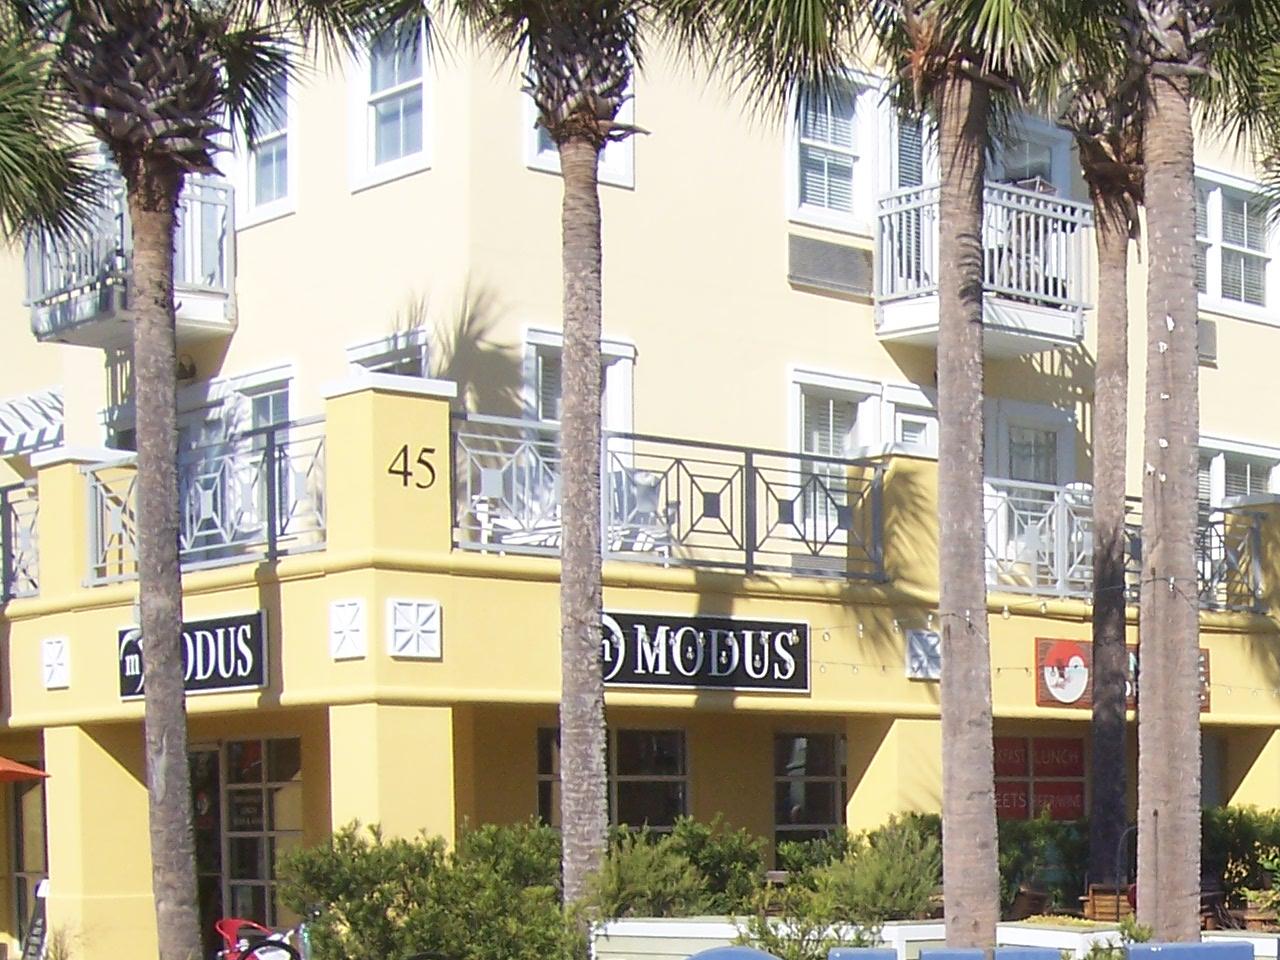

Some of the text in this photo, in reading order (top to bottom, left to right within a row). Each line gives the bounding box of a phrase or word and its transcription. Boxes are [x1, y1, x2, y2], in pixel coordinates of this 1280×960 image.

[387, 443, 436, 489] 45
[183, 624, 254, 682] ODUS
[633, 624, 796, 680] MODUS
[1034, 748, 1080, 766] LUNCH
